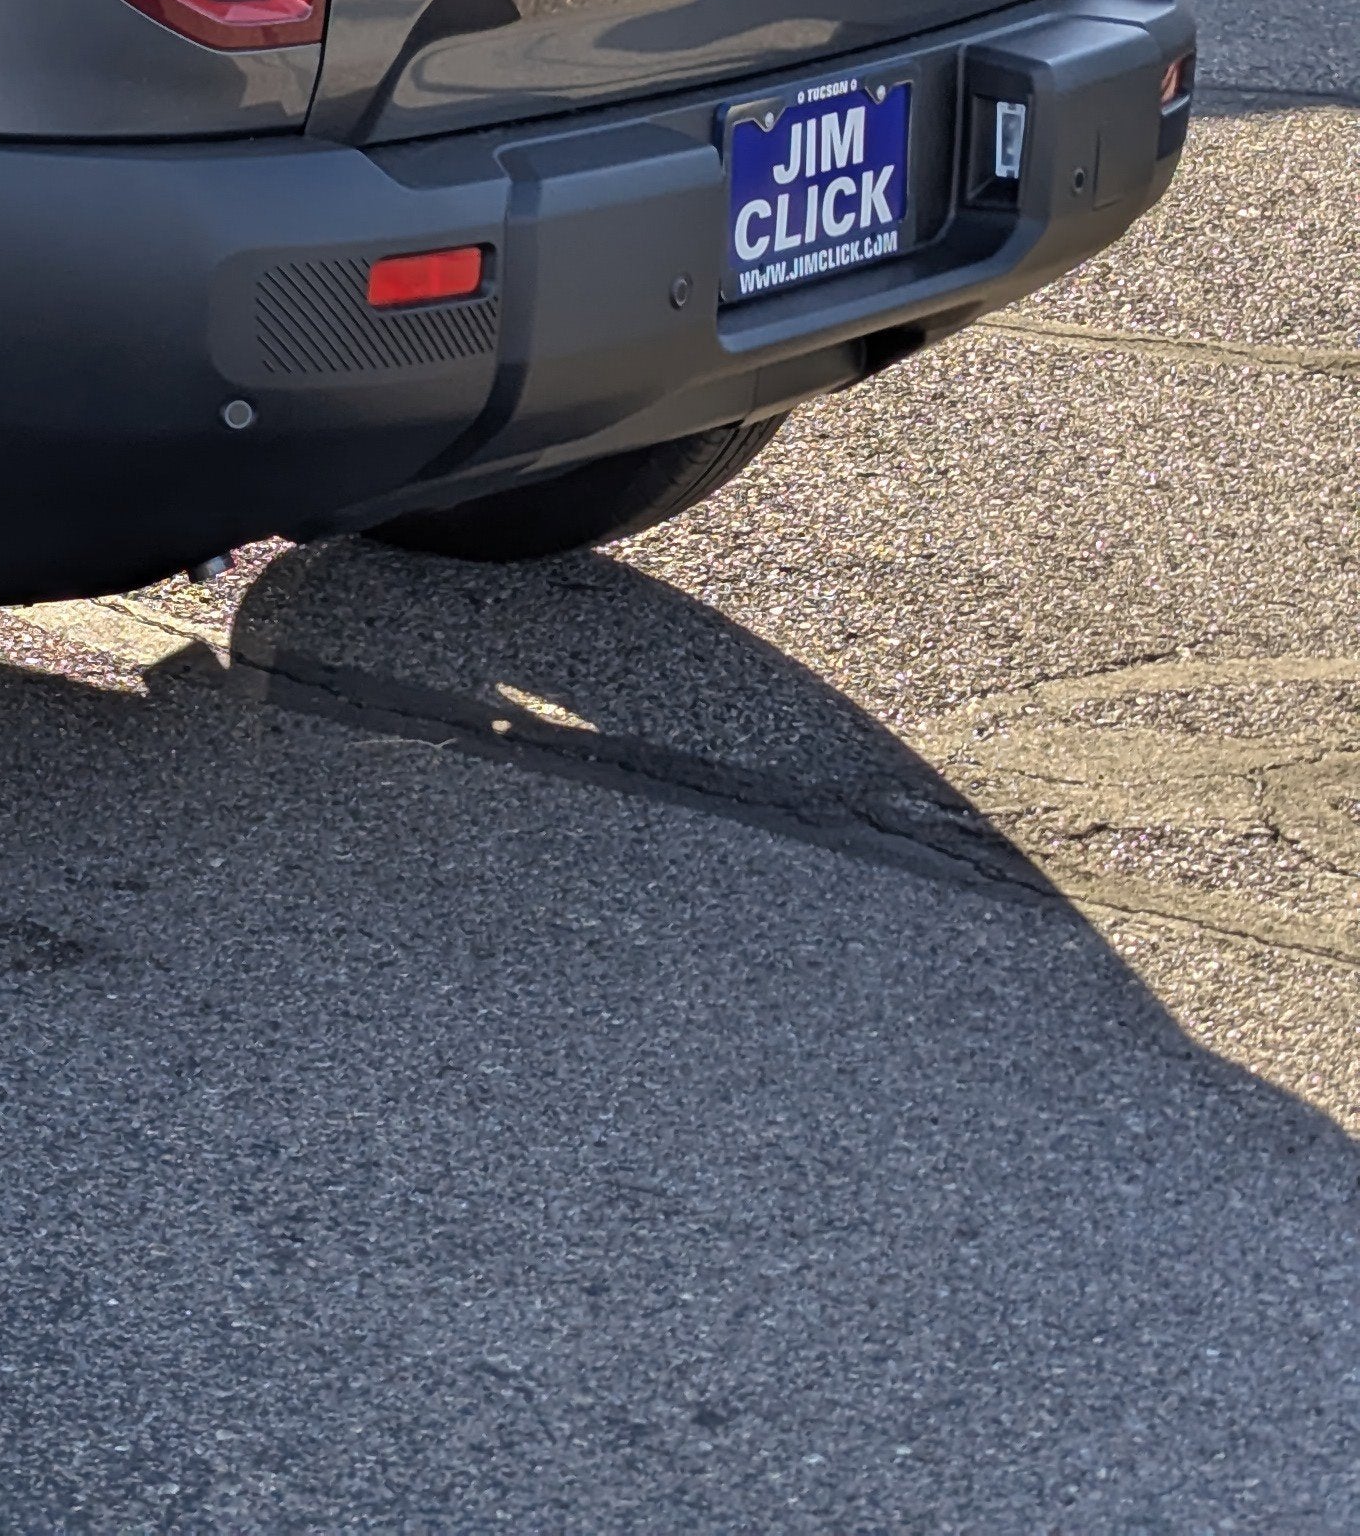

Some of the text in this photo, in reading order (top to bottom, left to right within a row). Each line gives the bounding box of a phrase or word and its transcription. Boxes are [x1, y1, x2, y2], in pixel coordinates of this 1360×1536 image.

[807, 80, 848, 102] TUCSON
[772, 105, 866, 184] JIM
[734, 164, 895, 261] CLICK
[739, 230, 898, 295] WWW.JIMCLICK.COM
